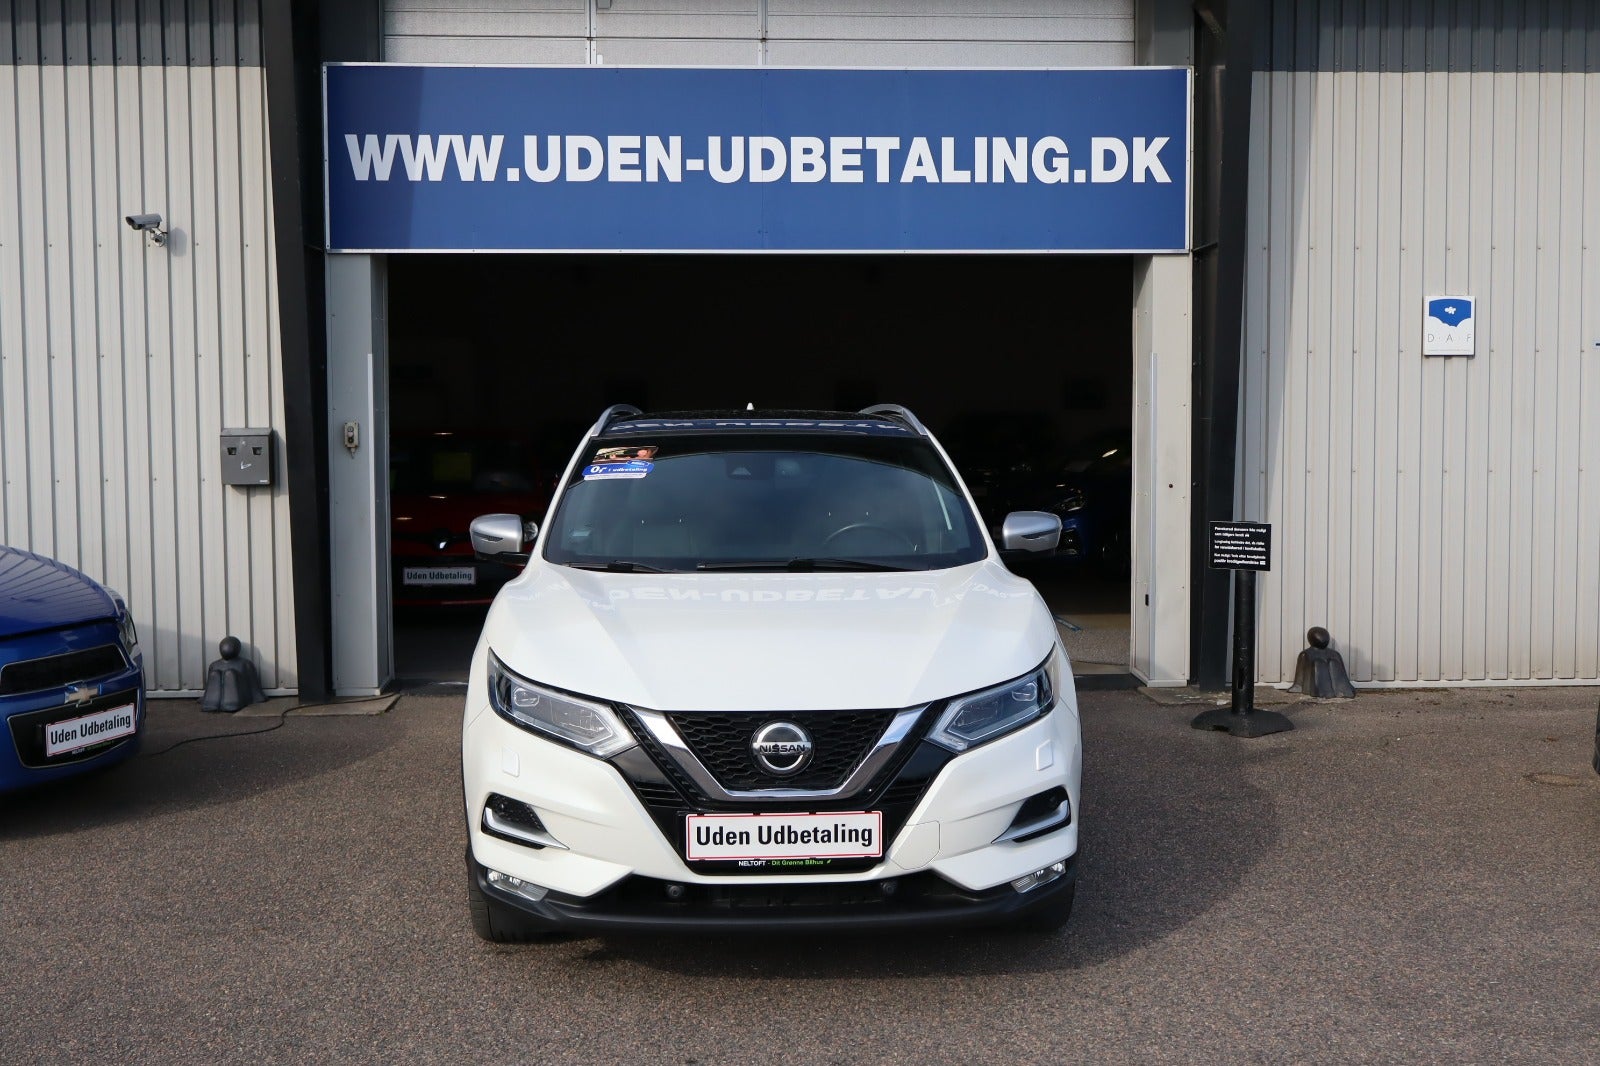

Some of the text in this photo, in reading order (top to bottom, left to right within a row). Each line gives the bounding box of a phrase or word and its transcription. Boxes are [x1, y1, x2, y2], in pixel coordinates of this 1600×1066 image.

[344, 134, 1172, 186] WWW.UDEN-UDBETALING.DK
[406, 571, 472, 581] Uden Udbetaling
[50, 715, 131, 745] Uden Udbetaling
[759, 744, 805, 753] NISSAN
[696, 823, 873, 847] Uden Udbetaling
